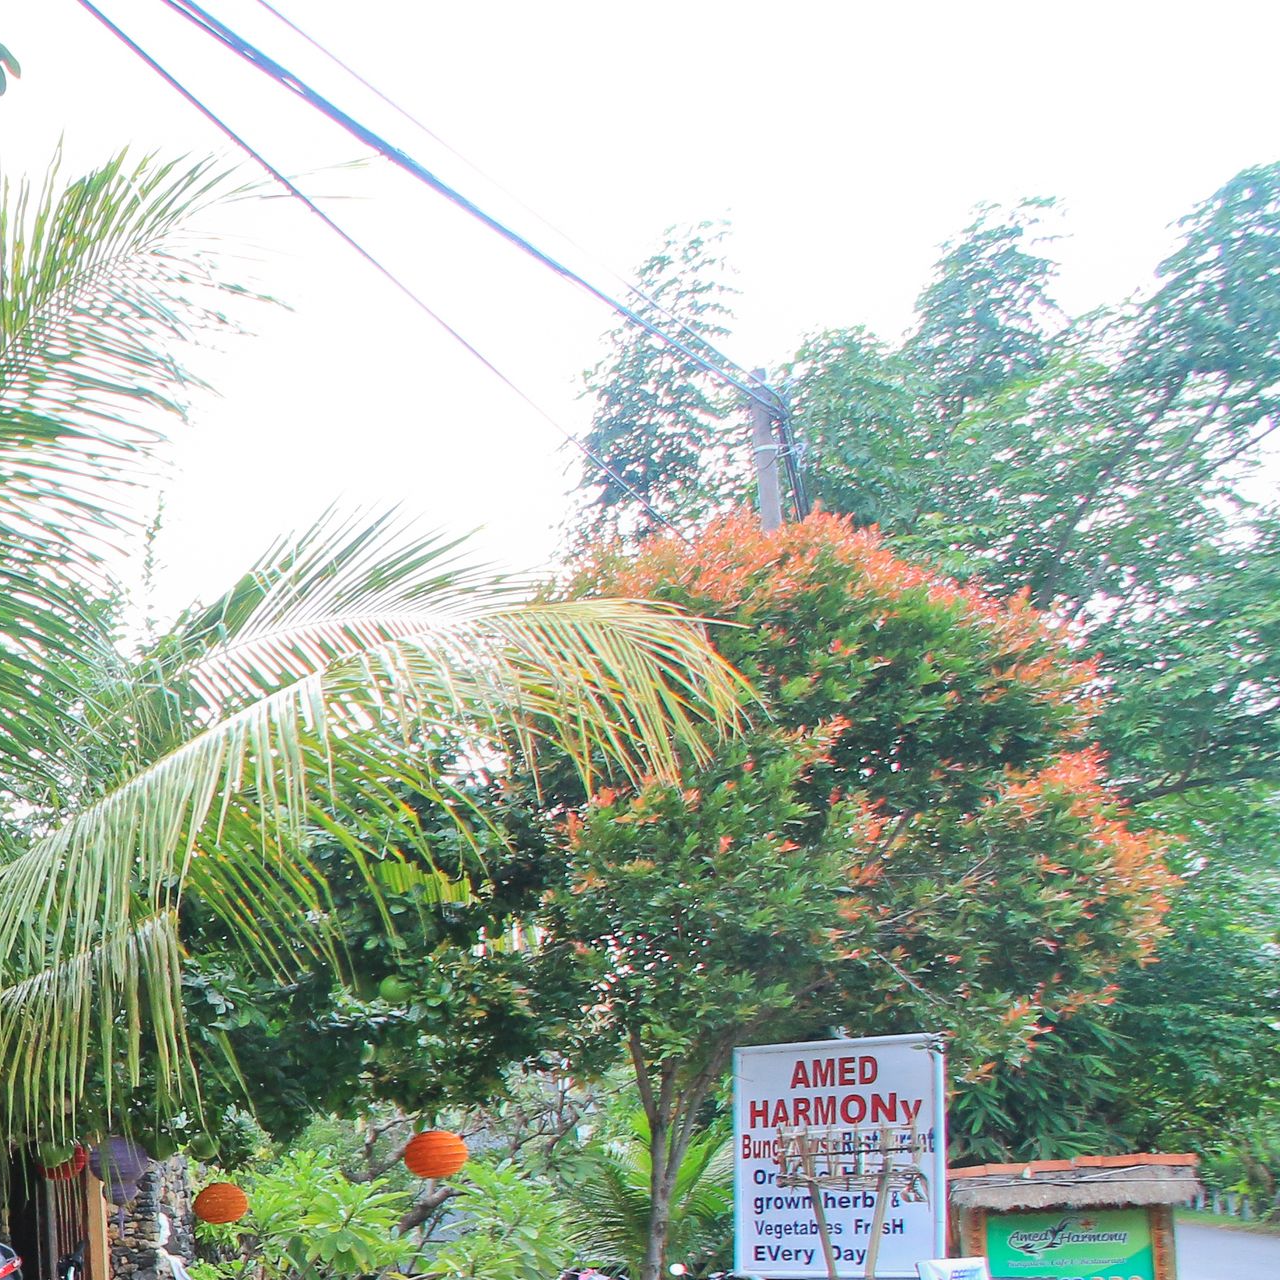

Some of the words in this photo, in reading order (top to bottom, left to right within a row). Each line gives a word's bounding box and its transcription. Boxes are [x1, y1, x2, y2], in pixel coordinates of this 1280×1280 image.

[790, 1055, 878, 1089] AMED
[754, 1196, 813, 1215] grown
[891, 1192, 901, 1208] &
[755, 1220, 843, 1239] Vegetabes
[854, 1218, 904, 1235] FrsH
[1009, 1231, 1048, 1245] Amed
[1060, 1230, 1127, 1245] Harmony
[754, 1246, 815, 1264] EVery
